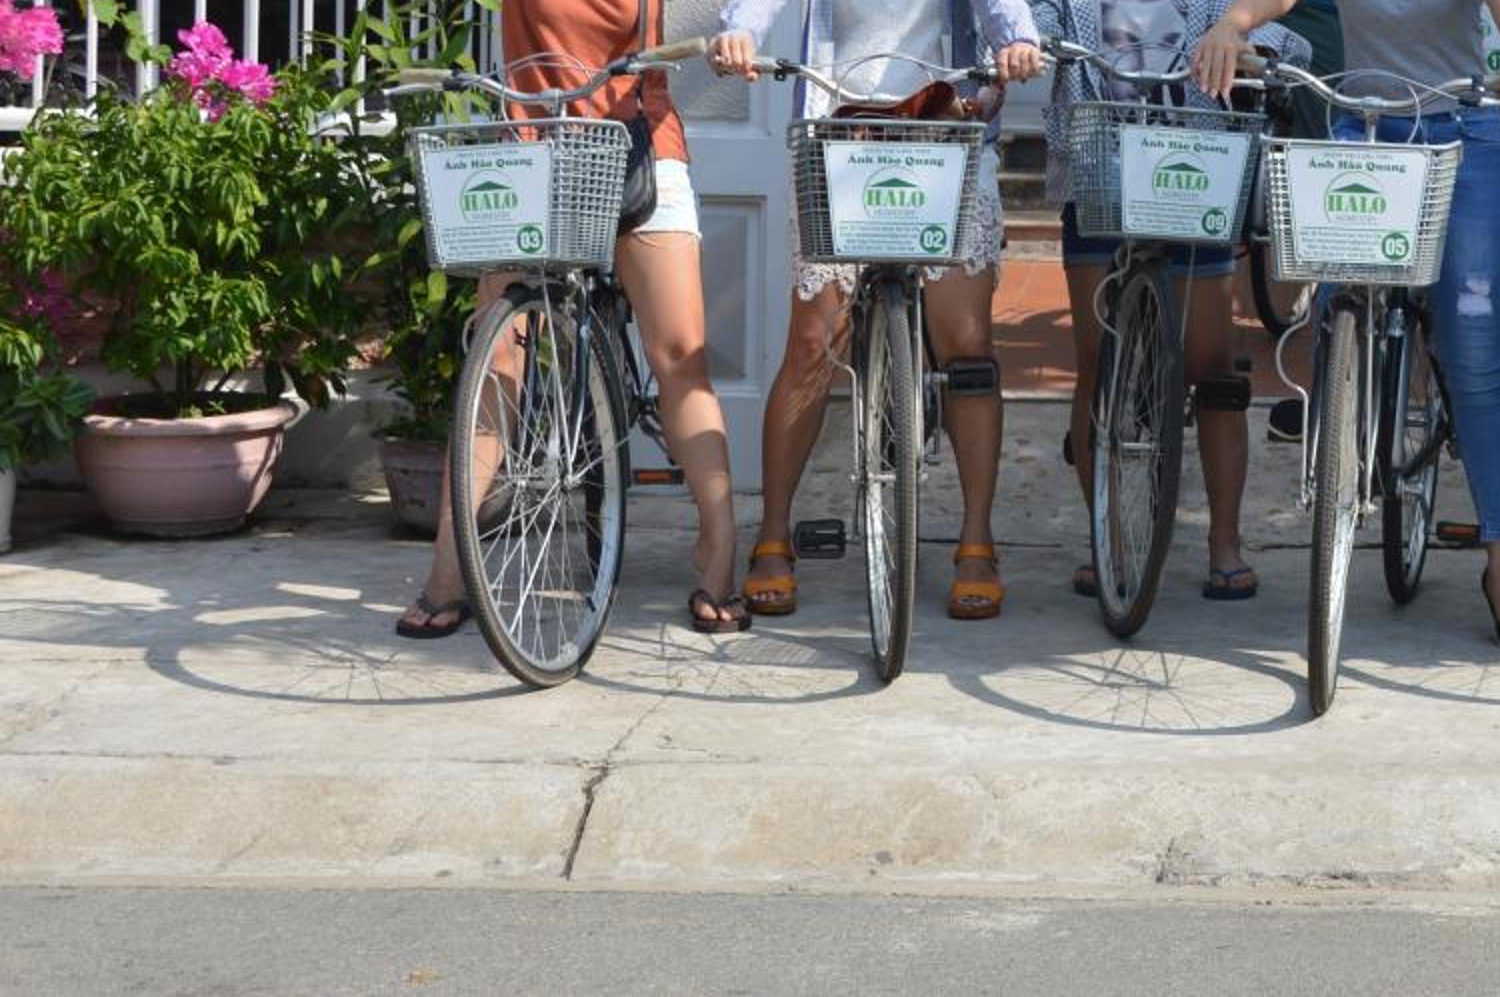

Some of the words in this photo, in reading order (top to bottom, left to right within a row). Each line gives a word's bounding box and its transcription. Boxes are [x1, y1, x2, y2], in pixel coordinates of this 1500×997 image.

[1155, 172, 1209, 191] HALO
[464, 190, 519, 212] HALO
[866, 188, 926, 207] HALO
[1326, 193, 1388, 215] HALO
[521, 229, 541, 248] 03
[922, 228, 944, 248] 02
[1386, 237, 1407, 256] 05
